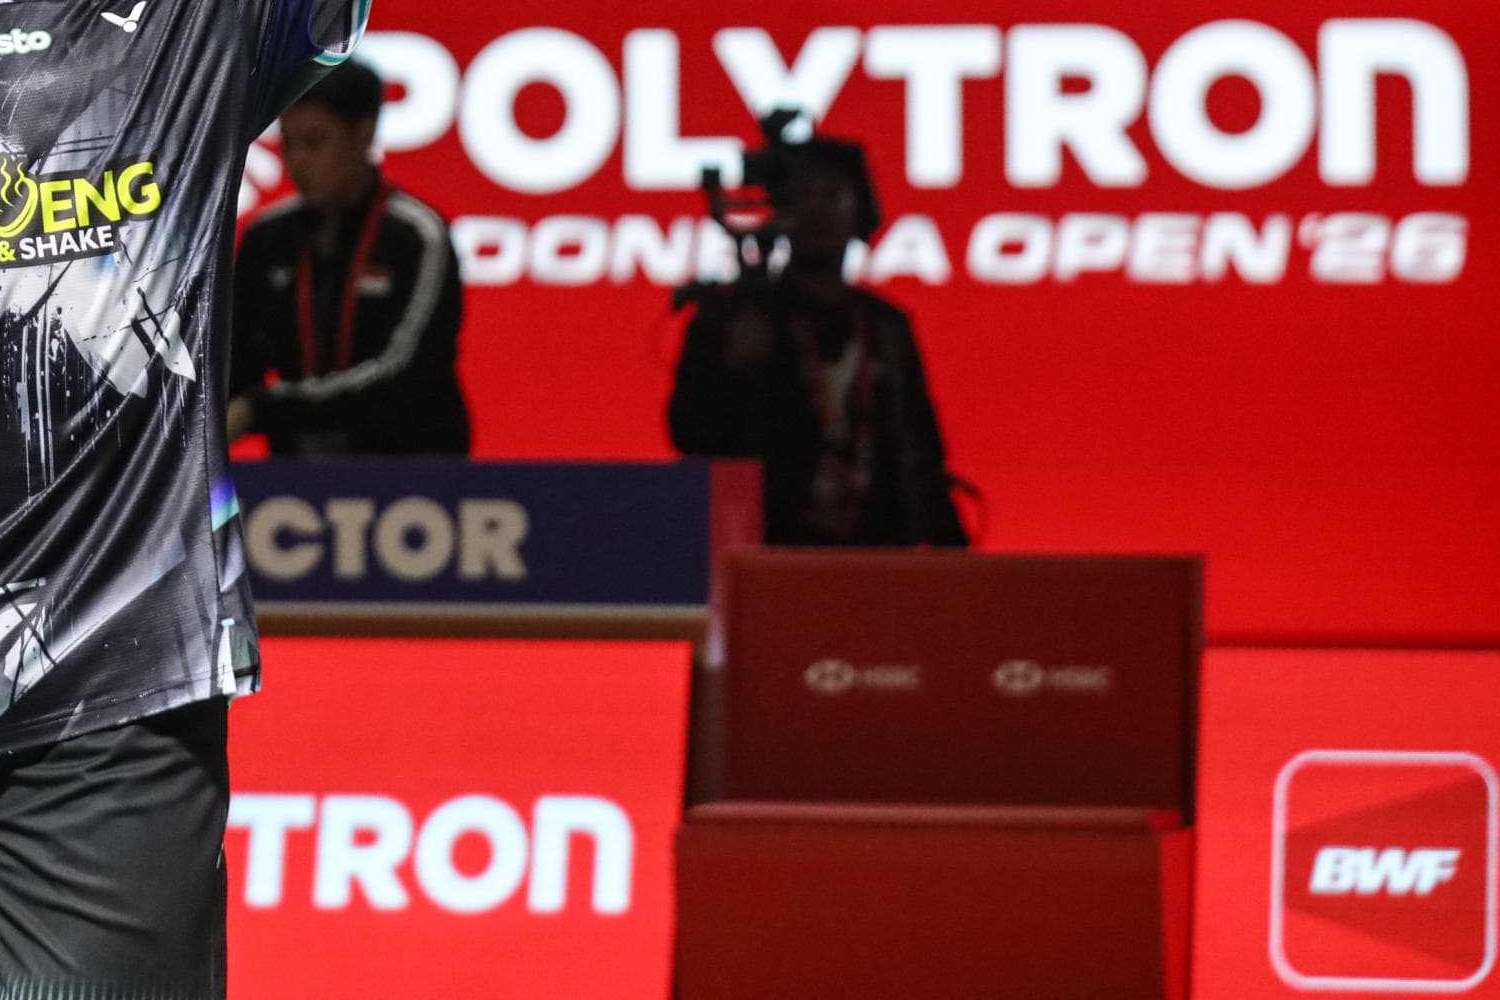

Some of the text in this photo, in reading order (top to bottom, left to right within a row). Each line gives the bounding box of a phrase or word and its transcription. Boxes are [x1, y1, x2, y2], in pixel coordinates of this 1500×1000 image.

[20, 225, 114, 260] SHAKE
[450, 213, 952, 286] DONEIA
[1309, 845, 1462, 895] BWF
